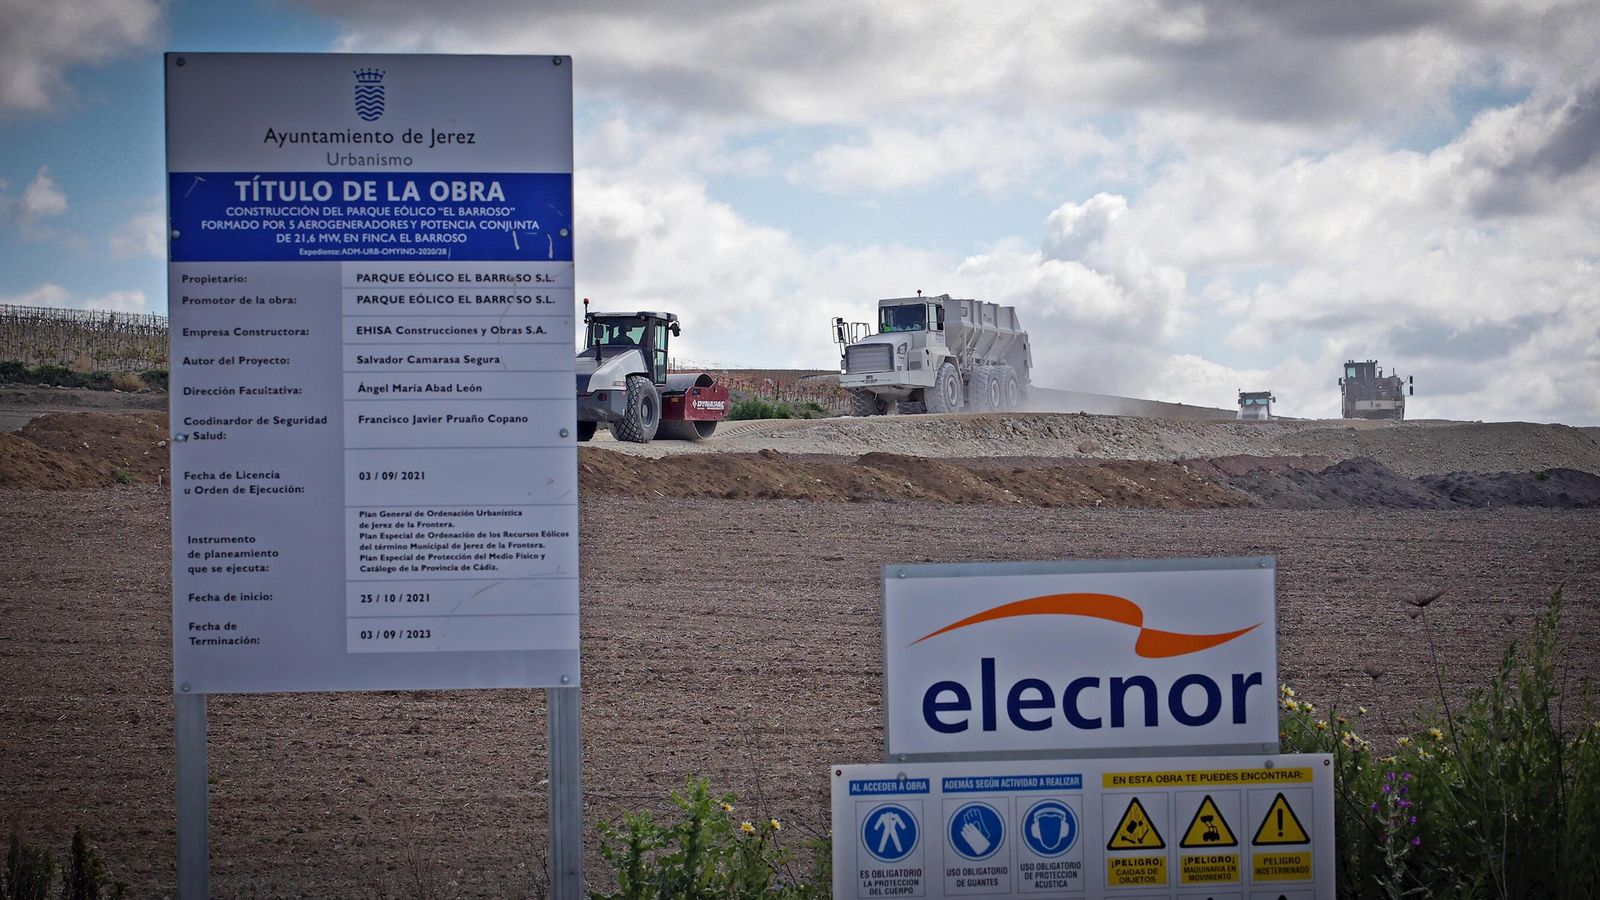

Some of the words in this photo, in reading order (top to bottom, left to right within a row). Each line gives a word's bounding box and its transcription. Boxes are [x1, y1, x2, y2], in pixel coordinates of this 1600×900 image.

[264, 127, 394, 148] Ayuntamiento
[402, 128, 423, 144] de
[429, 128, 476, 148] Jerez
[326, 152, 413, 167] Urbanismo
[234, 175, 333, 202] TÍTULO
[343, 181, 377, 201] DE
[387, 181, 421, 202] LA
[429, 181, 506, 202] OBRA
[226, 205, 320, 217] CONSTRUCCIÓN
[323, 206, 344, 216] DEL
[346, 206, 391, 218] PARQUE
[394, 205, 436, 217] EÓLICO
[201, 220, 260, 230] FORMADO
[263, 220, 286, 230] POR
[289, 220, 295, 230] 5
[297, 220, 409, 230] AEROGENERADORES
[410, 220, 418, 229] Y
[420, 220, 477, 230] POTENCIA
[479, 220, 540, 232] CONJUNTA
[276, 233, 291, 243] DE
[319, 233, 342, 244] MW,
[343, 233, 359, 243] EN
[362, 233, 397, 243] FINCA
[399, 233, 412, 243] EL
[415, 233, 467, 243] BARROSO
[182, 274, 248, 286] Propietario:
[356, 273, 405, 284] PARQUE
[409, 271, 454, 283] EÓLICO
[458, 273, 472, 283] EL
[535, 274, 555, 283] S.L.
[182, 296, 236, 305] Promotor
[239, 296, 253, 305] de
[255, 296, 266, 305] la
[268, 295, 297, 305] obra:
[182, 327, 230, 338] Empresa
[233, 327, 309, 337] Constructora:
[356, 326, 392, 335] EHISA
[395, 326, 478, 335] Construcciones
[481, 328, 487, 337] y
[490, 325, 523, 335] Obras
[525, 325, 547, 335] S.A.
[182, 356, 215, 366] Autor
[218, 356, 235, 365] del
[238, 356, 290, 367] Proyecto:
[357, 355, 404, 365] Salvador
[407, 355, 461, 364] Camarasa
[463, 354, 500, 366] Segura
[183, 386, 236, 396] Dirección
[357, 382, 389, 395] Ángel
[425, 383, 453, 393] Abad
[456, 383, 482, 393] León
[256, 416, 270, 425] de
[273, 415, 327, 428] Seguridad
[358, 415, 410, 424] Francisco
[412, 414, 443, 425] Javier
[446, 414, 485, 424] Pruaño
[487, 414, 528, 425] Copano
[183, 433, 190, 443] y
[193, 431, 227, 441] Salud:
[184, 471, 216, 480] Fecha
[219, 471, 232, 480] de
[236, 470, 281, 480] Licencia
[194, 485, 229, 495] Orden
[232, 485, 246, 494] de
[249, 485, 305, 496] Ejecución:
[359, 510, 377, 518] Plan
[379, 510, 412, 518] General
[414, 510, 425, 518] de
[371, 522, 393, 530] Jerez
[394, 521, 405, 529] de
[188, 535, 256, 544] Instrumento
[359, 532, 378, 540] Plan
[379, 532, 413, 541] Especial
[427, 531, 475, 539] Ordenación
[477, 531, 487, 539] de
[541, 530, 570, 538] Eólicos
[359, 543, 372, 551] del
[374, 543, 408, 551] término
[410, 542, 449, 552] Municipal
[451, 542, 461, 550] de
[463, 542, 484, 551] Jerez
[508, 541, 546, 549] Frontera.
[187, 550, 201, 559] de
[204, 549, 279, 561] planeamiento
[187, 566, 208, 576] que
[226, 563, 269, 575] ejecuta:
[359, 565, 397, 574] Catálogo
[421, 564, 459, 572] Provincia
[460, 564, 471, 572] de
[188, 593, 220, 602] Fecha
[223, 592, 237, 602] de
[240, 592, 273, 601] inicio:
[189, 622, 221, 631] Fecha
[224, 621, 237, 631] de
[360, 630, 373, 640] 03
[383, 630, 396, 639] 09
[406, 629, 431, 639] 2023
[188, 636, 260, 646] Terminación:
[922, 657, 1263, 734] elecnor
[944, 778, 975, 790] ADEMÁS
[975, 777, 1000, 789] SEGÚN
[1000, 777, 1038, 788] ACTIVIDAD
[1038, 777, 1046, 787] A
[1045, 776, 1081, 787] REALIZAR
[1112, 776, 1126, 785] EN
[1128, 775, 1154, 785] ESTA
[1155, 774, 1183, 784] OBRA
[1185, 774, 1198, 783] TE
[1200, 773, 1239, 782] PUEDES
[1241, 771, 1303, 781] ENCONTRAR:
[851, 784, 862, 793] AL
[863, 783, 898, 792] ACCEDER
[898, 783, 905, 791] A
[905, 781, 928, 791] OBRA
[1263, 856, 1301, 866] PELIGRO
[860, 870, 870, 879] ES
[871, 868, 922, 879] OBLIGATORIO
[946, 868, 961, 877] USO
[962, 866, 1008, 876] OBLIGATORIO
[956, 879, 966, 888] DE
[967, 877, 999, 888] GUANTES
[869, 887, 883, 896] DEL
